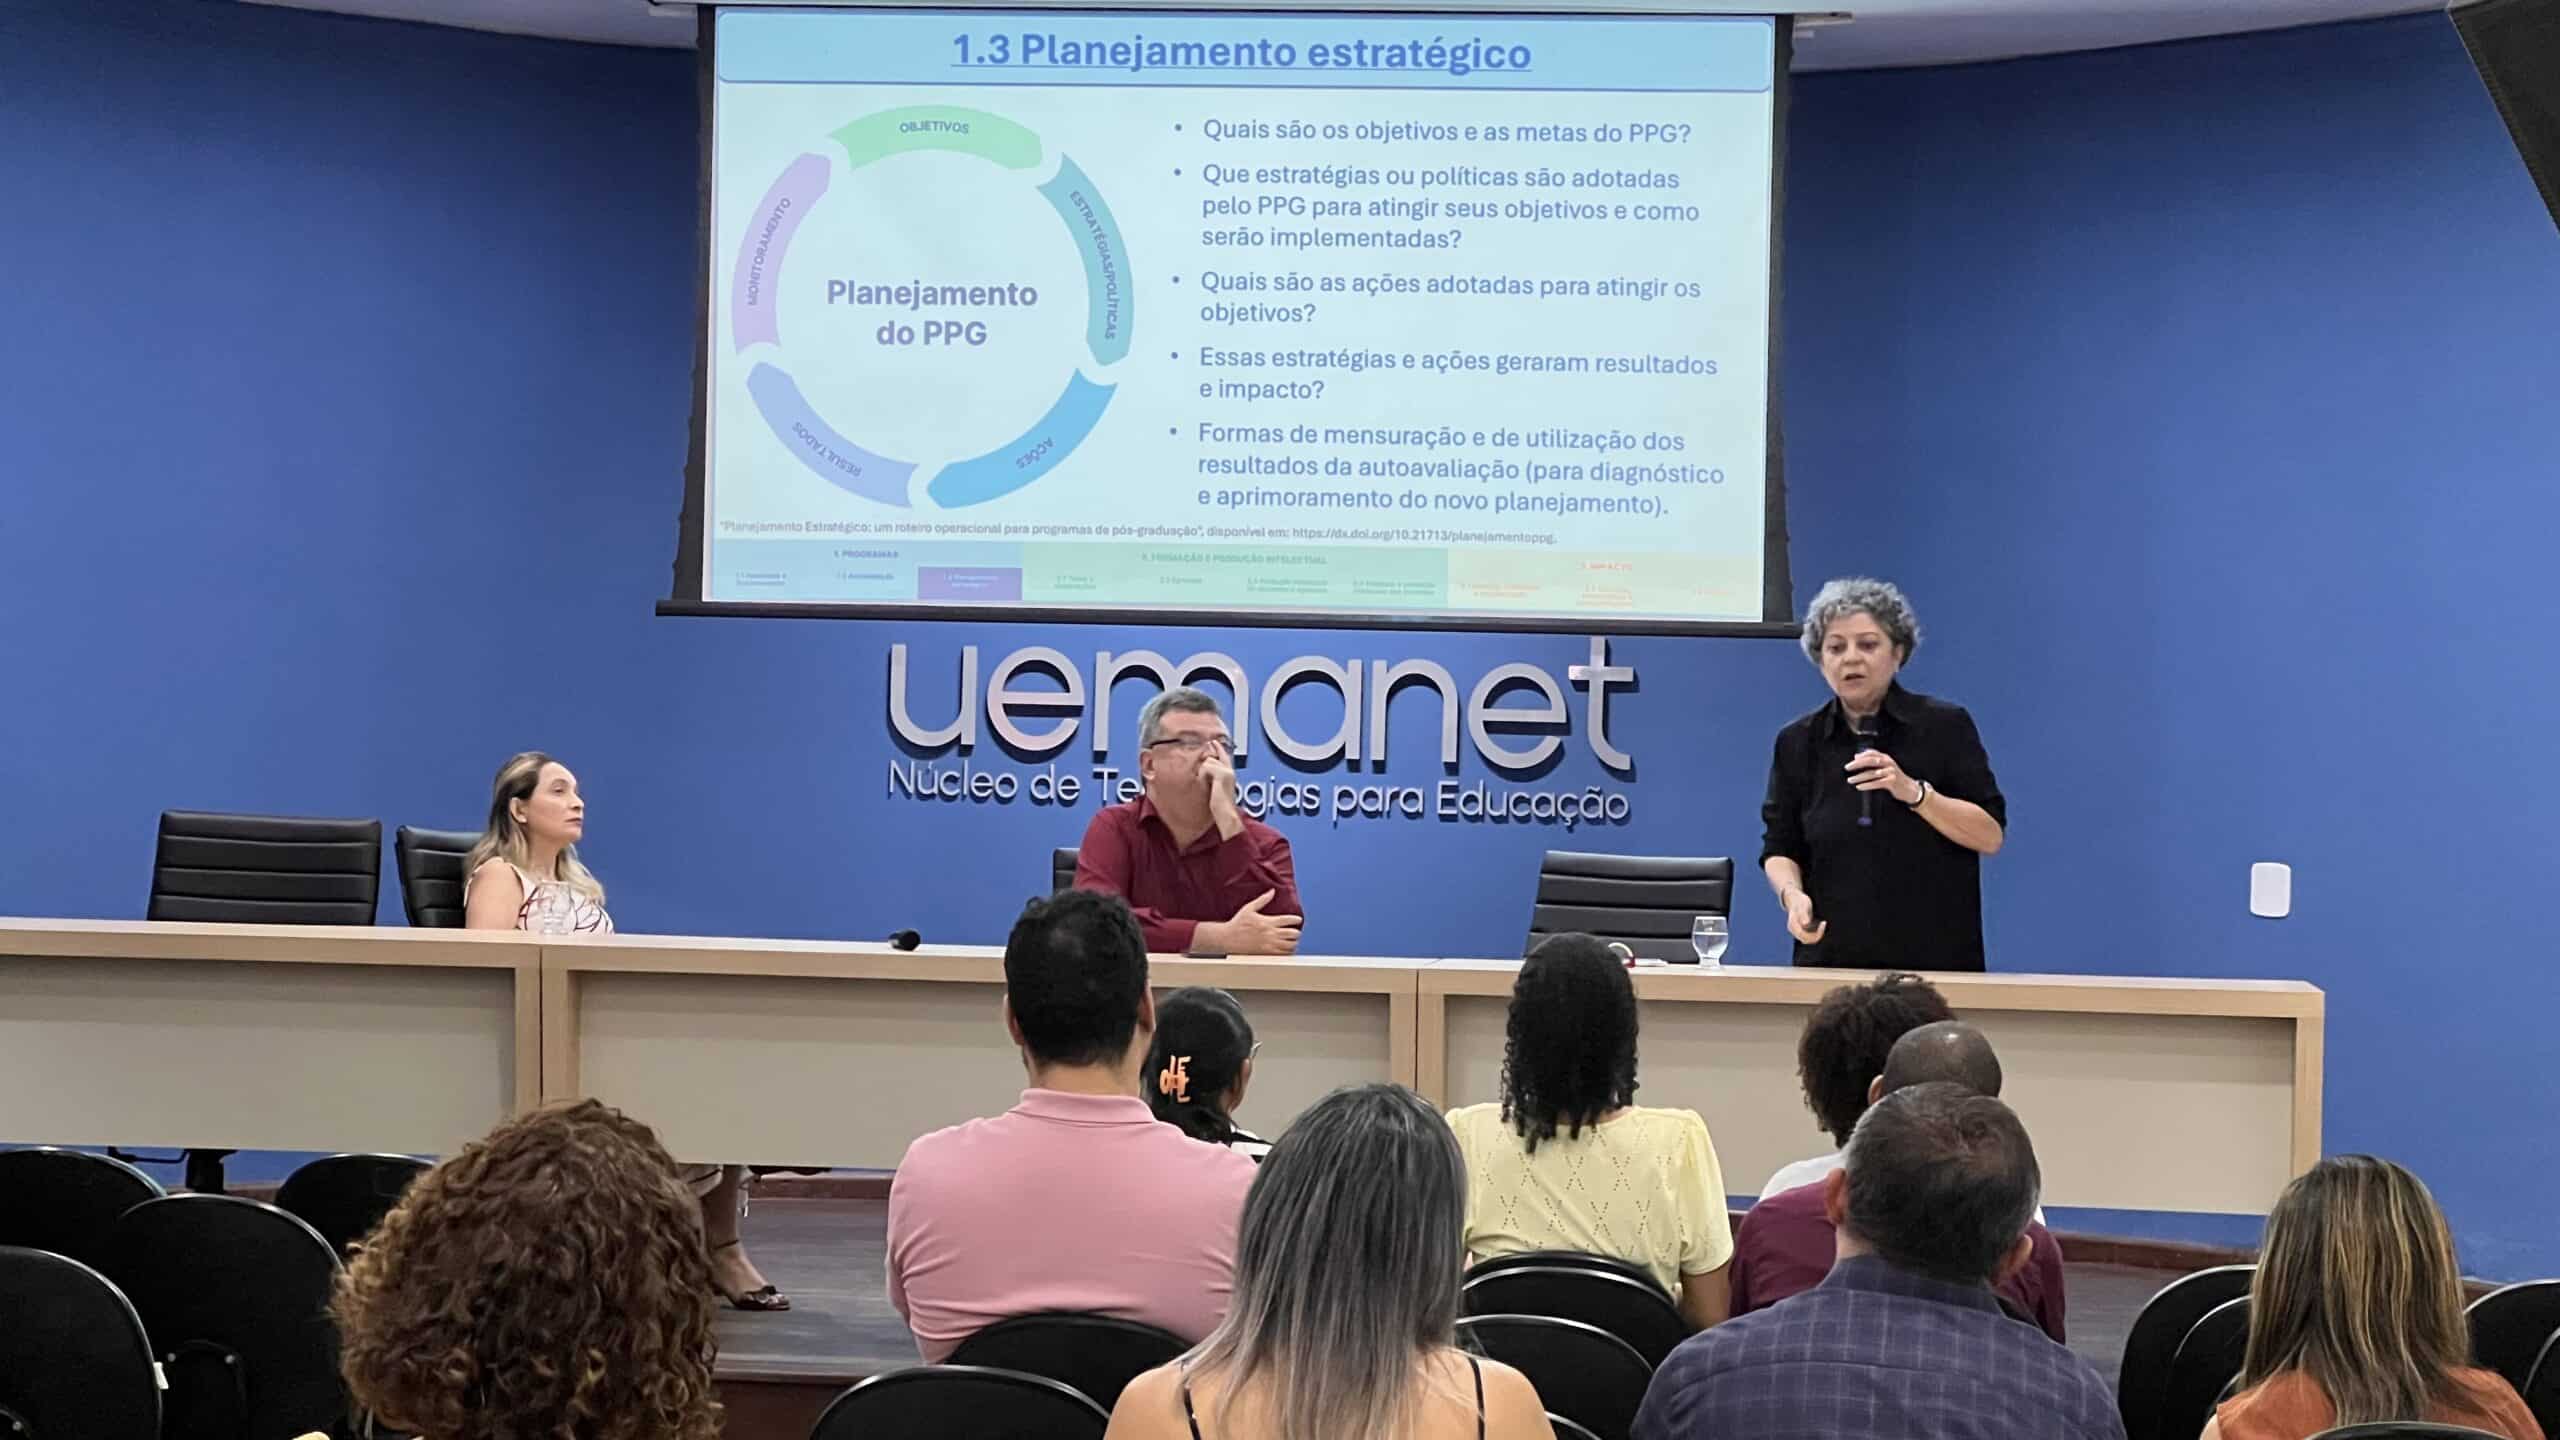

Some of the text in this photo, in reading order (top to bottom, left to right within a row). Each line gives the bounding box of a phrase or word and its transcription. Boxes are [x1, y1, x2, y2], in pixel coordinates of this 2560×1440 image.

[952, 33, 1532, 76] 1.3 Planejamento estratégico
[899, 120, 970, 134] OBJETIVOS
[1203, 118, 1692, 145] Quais são os objetivos e as metas do PPG?
[1202, 163, 1681, 191] Que estratégias ou políticas são adotadas
[1202, 194, 1700, 223] pelo PPG para atingir seus objetivos e como
[747, 198, 791, 306] MONITORAMENTO
[1201, 226, 1462, 252] serão implementadas?
[827, 279, 1039, 313] Planejamento
[1200, 270, 1701, 302] Quais são as ações adotadas para atingir os
[1200, 301, 1317, 327] objetivos?
[875, 319, 988, 347] do PPG
[1200, 346, 1718, 376] Essas estratégias e ações geraram resultados
[1199, 377, 1325, 403] e impacto?
[792, 421, 862, 478] RESULTADOS
[1199, 422, 1685, 453] Formas de mensuração e de utilização dos
[1016, 437, 1055, 470] AÇÕES
[1198, 455, 1725, 487] resultados da autoavaliação (para diagnóstico
[1197, 486, 1669, 518] e aprimoramento do novo planejamento).
[874, 523, 892, 535] um
[889, 636, 1635, 771] uemanet
[889, 760, 1019, 799] Núcleo
[1030, 763, 1081, 801] de
[1332, 783, 1425, 825] para
[1437, 779, 1630, 826] Educação
